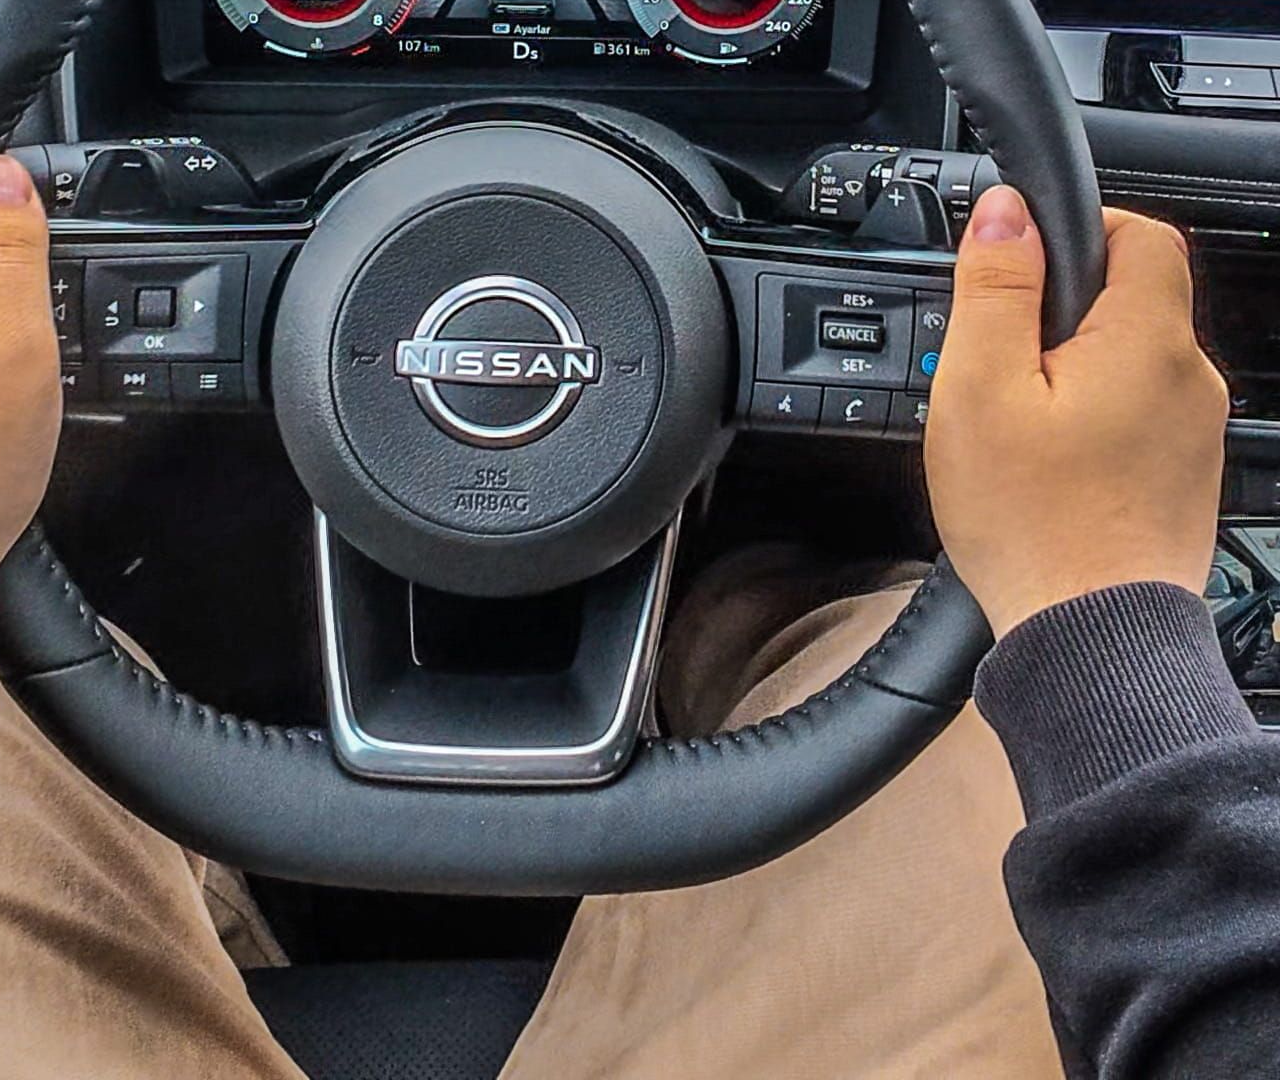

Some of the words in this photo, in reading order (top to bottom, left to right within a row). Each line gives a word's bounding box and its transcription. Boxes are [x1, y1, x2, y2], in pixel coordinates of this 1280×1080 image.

[249, 14, 258, 23] 0
[373, 14, 383, 25] 8
[513, 24, 551, 36] Ayarlar
[660, 22, 669, 31] 0
[765, 21, 791, 32] 240
[398, 41, 421, 52] 107
[423, 43, 440, 52] km
[513, 41, 539, 59] Ds
[608, 44, 631, 56] 361
[634, 45, 651, 56] km
[821, 177, 837, 185] OFF
[821, 187, 844, 196] AUTO
[843, 294, 874, 307] RES+
[827, 327, 878, 343] CANCEL
[144, 335, 165, 349] OK
[401, 346, 595, 379] NISSAN
[475, 468, 509, 488] SRS
[453, 492, 529, 513] AIRBAG
